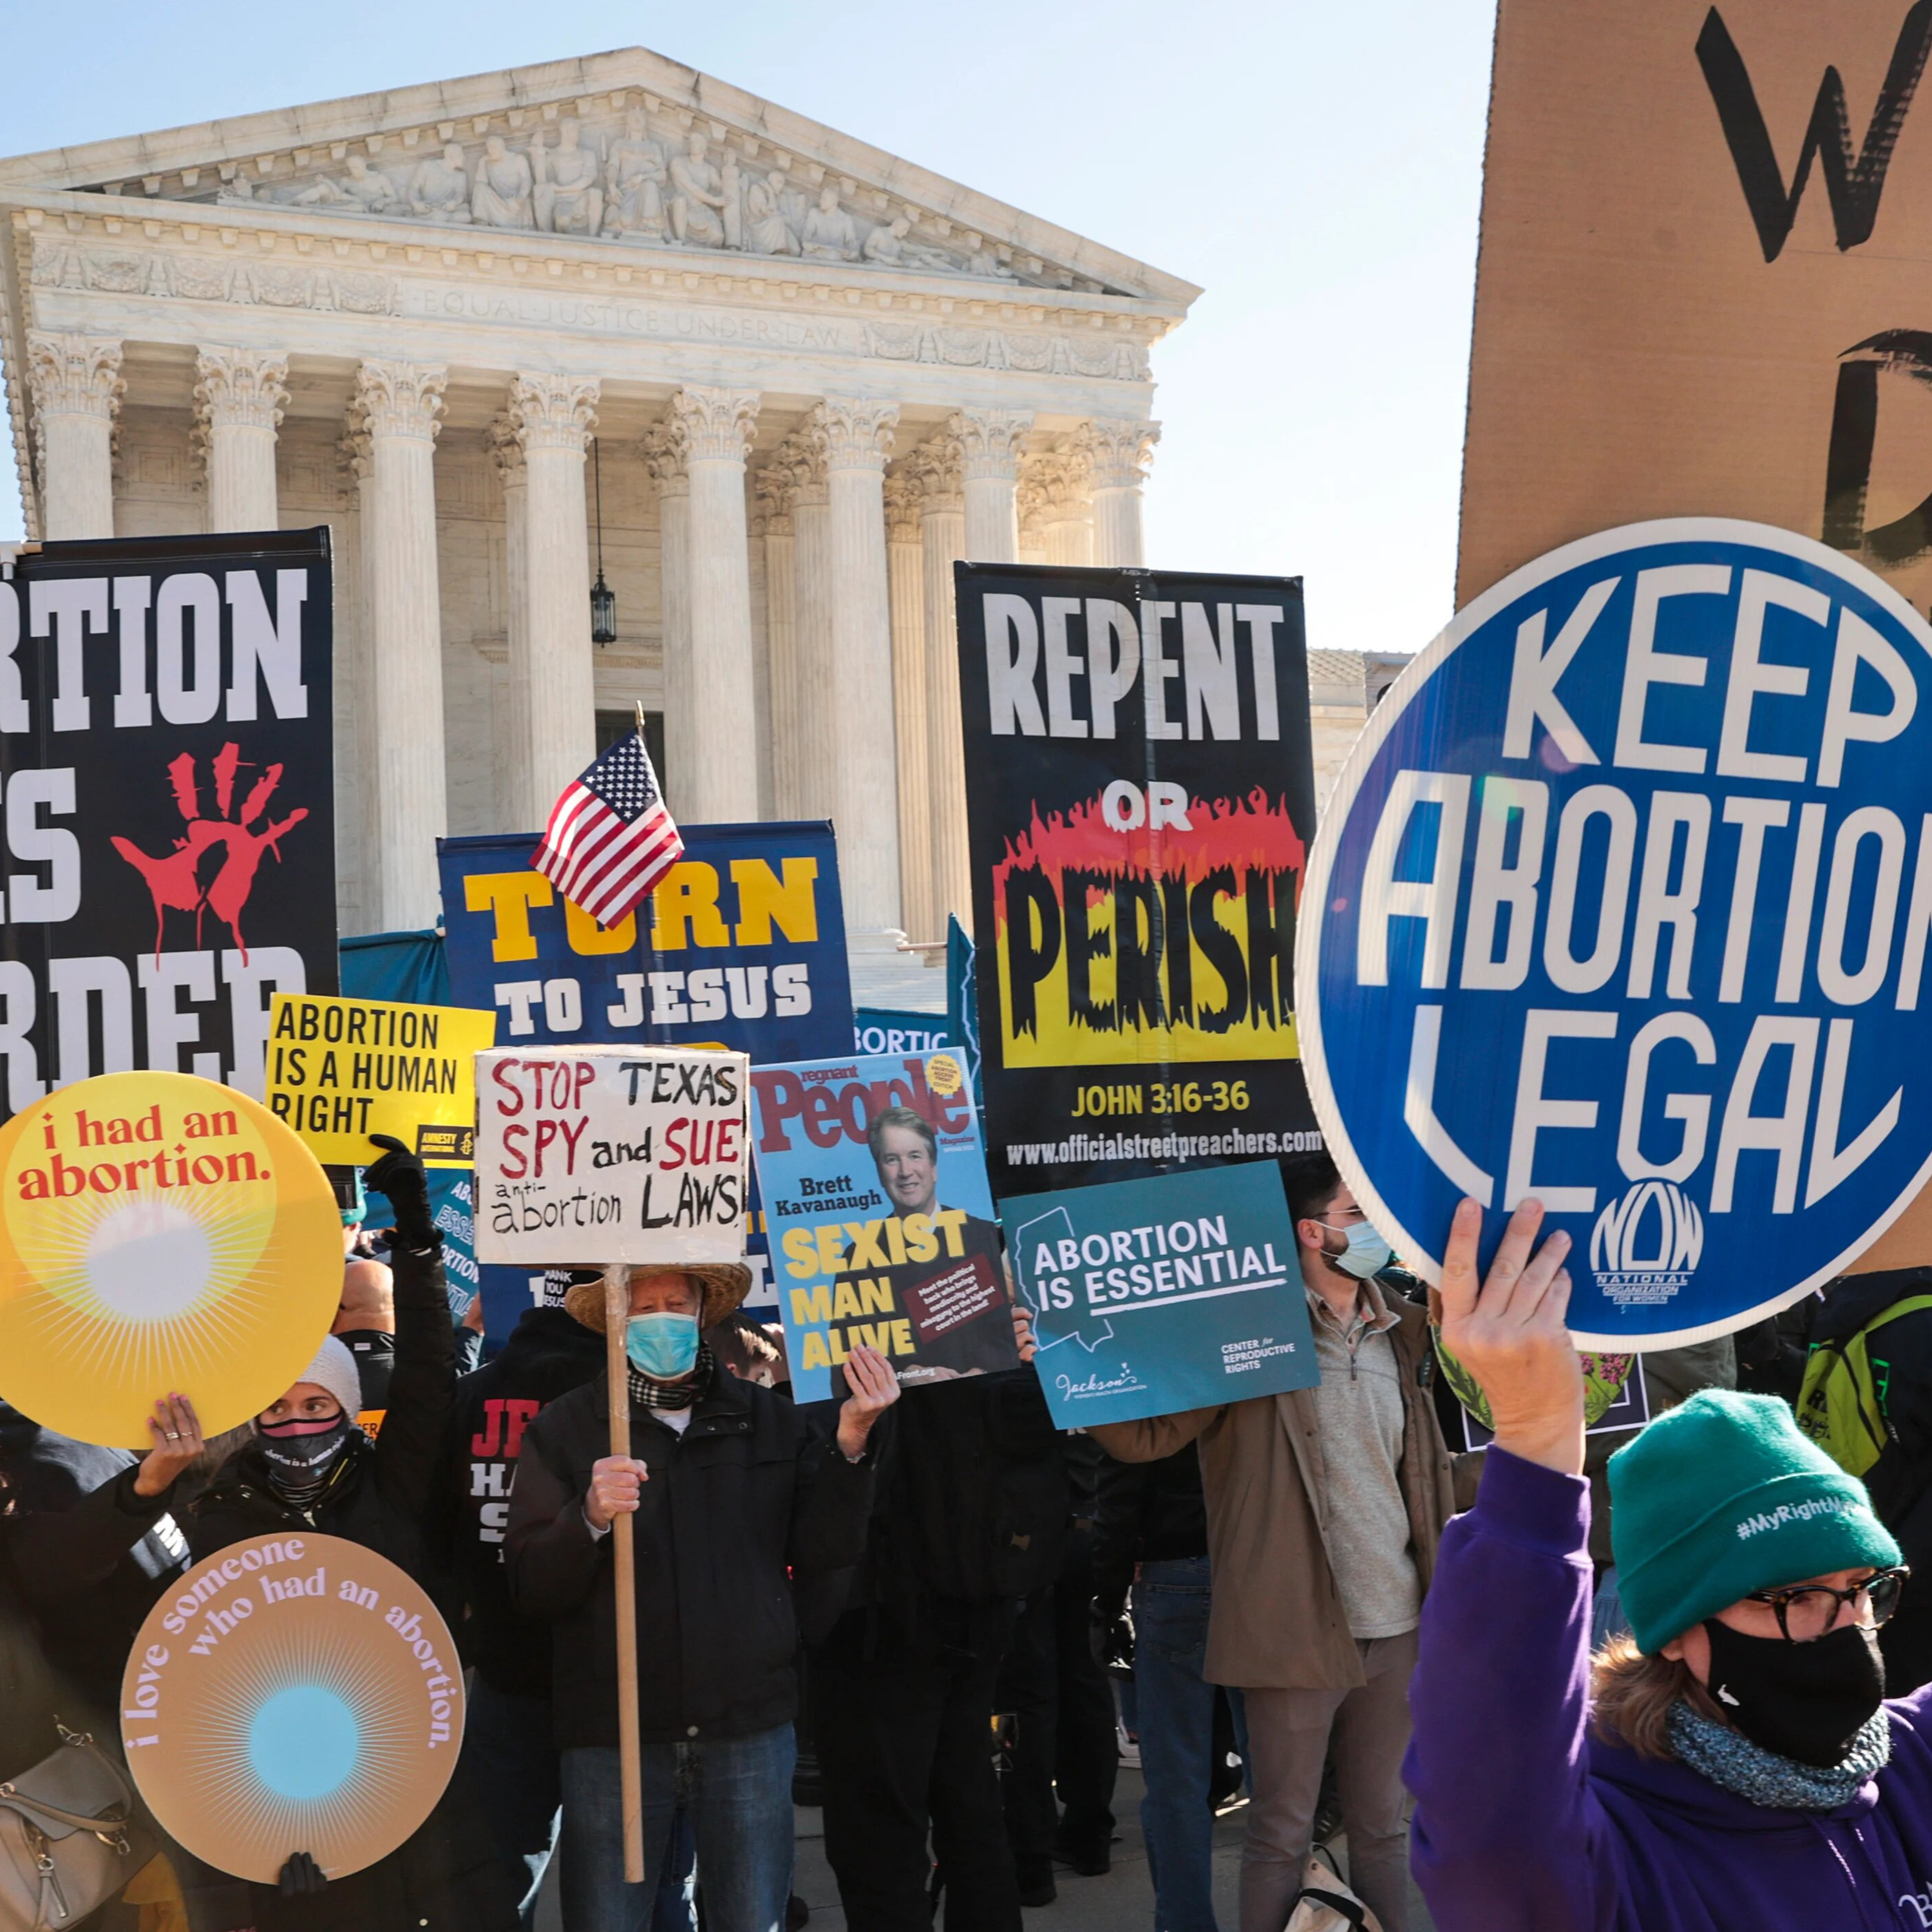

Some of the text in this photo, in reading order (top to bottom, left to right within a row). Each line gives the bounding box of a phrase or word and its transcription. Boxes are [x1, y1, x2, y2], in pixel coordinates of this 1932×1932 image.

[424, 290, 841, 346] EQUAL JUSTICE UNDER LAW
[982, 592, 1284, 741] REPENT
[1502, 564, 1918, 788] KEEP
[1102, 779, 1193, 833] OR
[1004, 861, 1298, 1044] PERISH
[495, 963, 812, 1036] TO JESUS
[275, 1002, 439, 1050] ABORTION
[275, 1047, 457, 1095] IS A HUMAN
[492, 1057, 737, 1117] STOP TEXAS
[801, 1065, 859, 1084] regnant
[272, 1094, 374, 1134] RIGHT
[1071, 1081, 1250, 1117] JOHN 3:16-36
[1404, 1005, 1903, 1215] LEGAL
[42, 1104, 239, 1150] i had an
[421, 1132, 458, 1144] AMNESTY
[499, 1115, 742, 1179] SPY and SUE
[1007, 1128, 1323, 1166] www.officialstreetpreachers.com
[18, 1143, 270, 1200] abortion.
[495, 1181, 547, 1198] anti-
[799, 1174, 853, 1197] Brett
[491, 1186, 621, 1234] abortion
[775, 1189, 883, 1217] Kavanaugh
[1589, 1181, 1704, 1272] NOW
[781, 1208, 969, 1280] SEXIST
[1034, 1215, 1228, 1275] ABORTION
[789, 1276, 896, 1327] MAN
[918, 1263, 976, 1297] Meet the political
[929, 1282, 979, 1313] mediocrity and
[940, 1285, 956, 1296] who
[954, 1274, 977, 1289] brings
[1037, 1243, 1287, 1312] IS ESSENTIAL
[1596, 1274, 1689, 1284] NATIONAL
[1602, 1285, 1679, 1294] ORGANIZATION
[920, 1308, 953, 1329] misogyny
[959, 1298, 972, 1308] the
[970, 1285, 996, 1302] highest
[935, 1317, 954, 1331] court
[960, 1308, 973, 1318] the
[802, 1318, 916, 1370] ALIVE
[1221, 1337, 1274, 1354] CENTER for
[1223, 1343, 1296, 1364] REPRODUCTIVE
[1225, 1360, 1261, 1374] RIGHTS
[292, 1458, 300, 1467] is
[162, 1539, 305, 1635] someone
[124, 1644, 170, 1719] love
[188, 1567, 458, 1749] who had an abortion.
[124, 1734, 159, 1748] i
